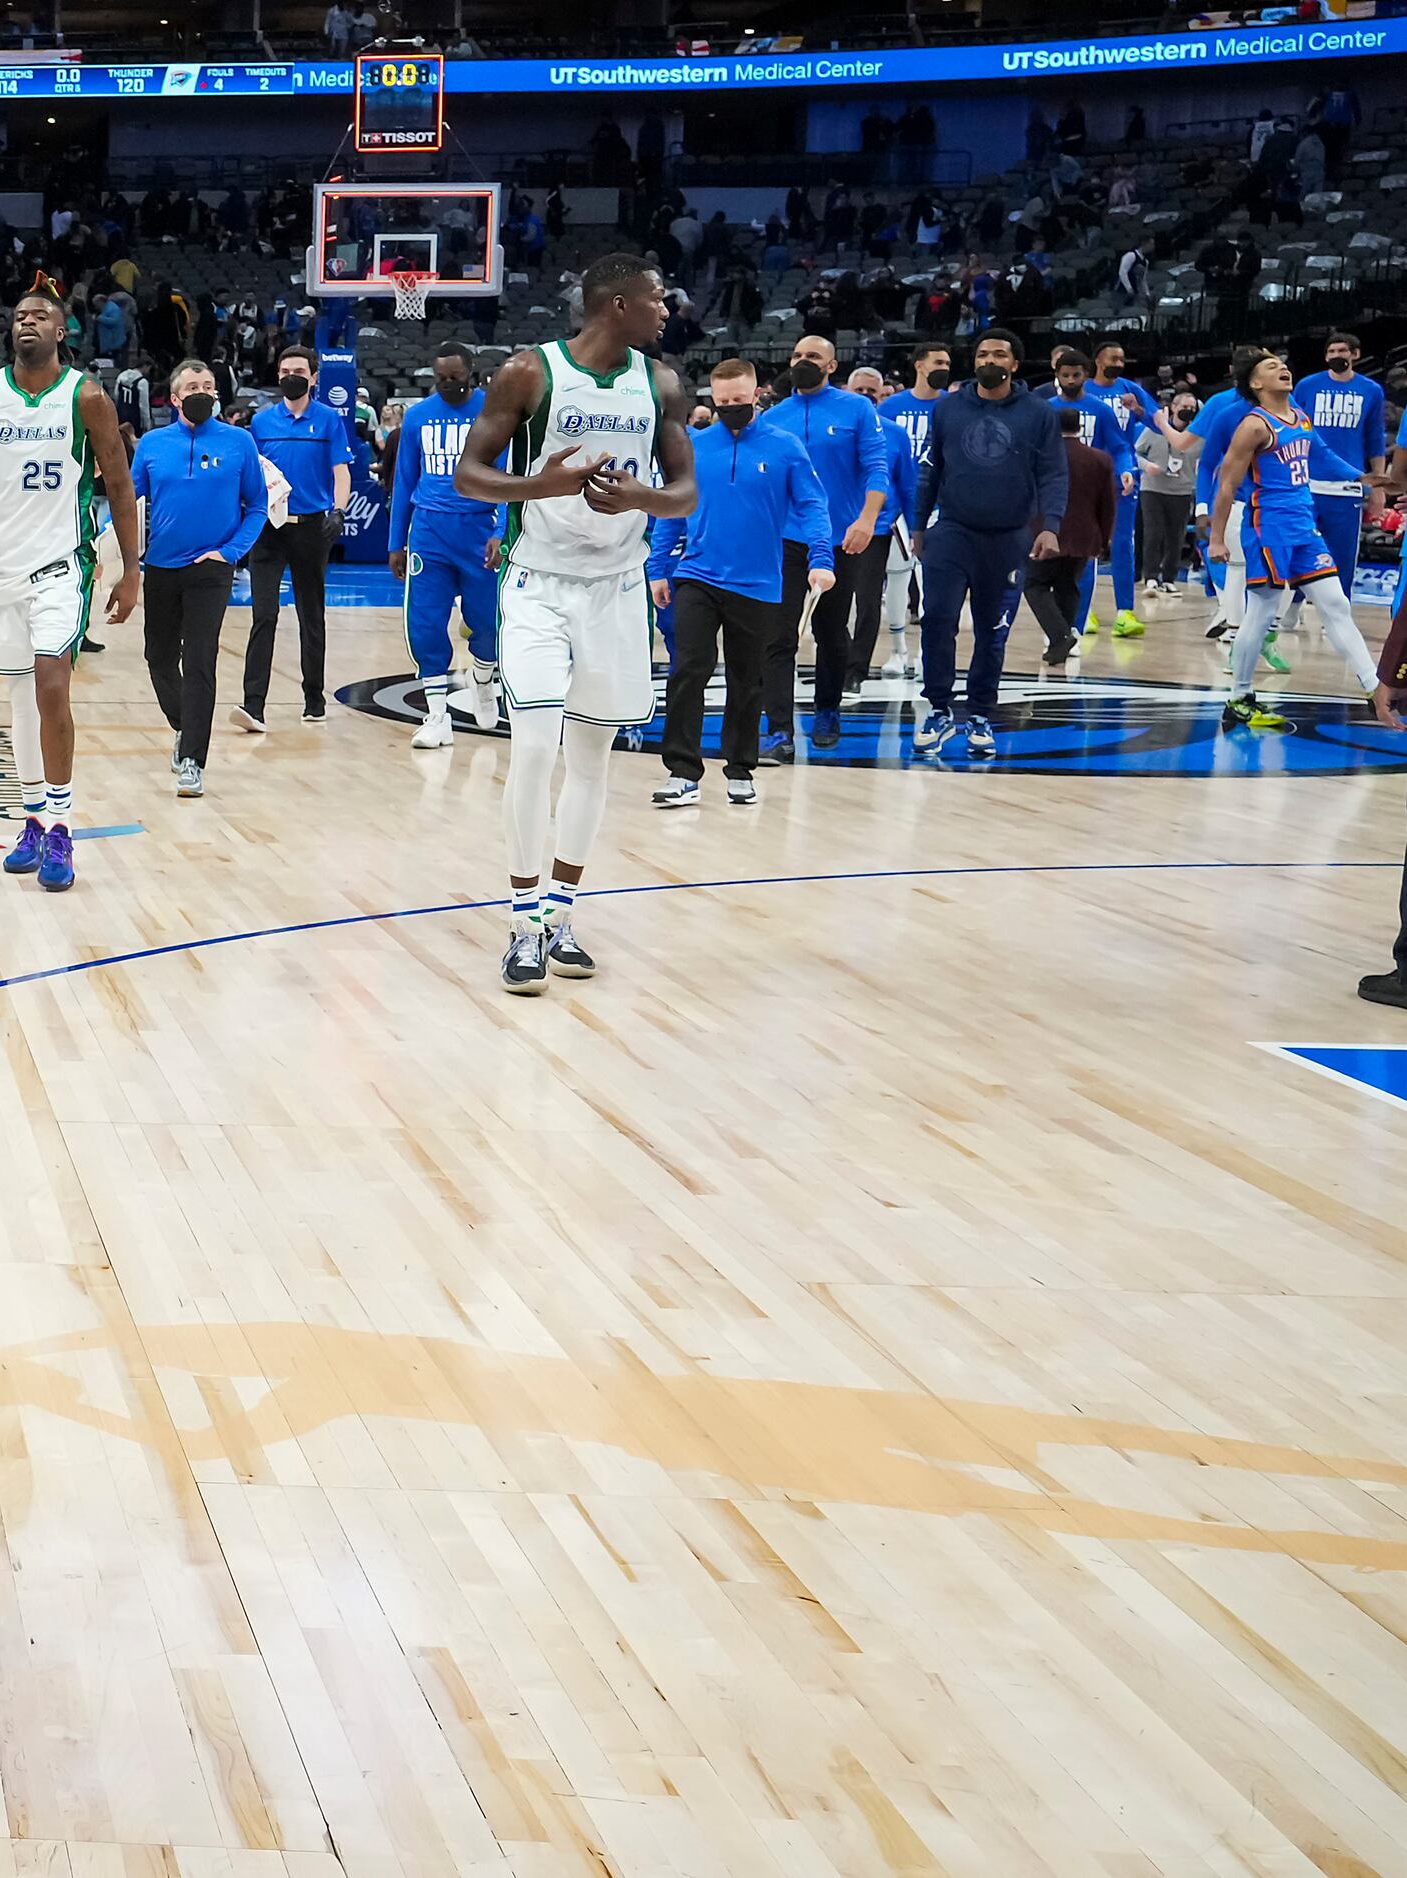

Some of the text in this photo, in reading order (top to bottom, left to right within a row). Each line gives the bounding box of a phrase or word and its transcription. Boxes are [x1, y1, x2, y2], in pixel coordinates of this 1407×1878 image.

[1215, 33, 1303, 57] Medical
[1308, 30, 1386, 51] Center
[56, 68, 80, 83] 0.0
[108, 68, 153, 78] THUNDER
[206, 67, 286, 77] FOULS TIMEOUTS
[735, 60, 811, 81] Medical
[816, 59, 883, 78] Center
[116, 78, 144, 94] 120
[213, 78, 269, 92] 4 2
[382, 132, 436, 143] TISSOT
[1314, 393, 1364, 415] BLACK
[562, 413, 651, 434] DALLAS
[1313, 412, 1362, 428] HISTORY
[421, 423, 472, 455] BLAC
[22, 460, 64, 491] 25
[1290, 458, 1310, 486] 23
